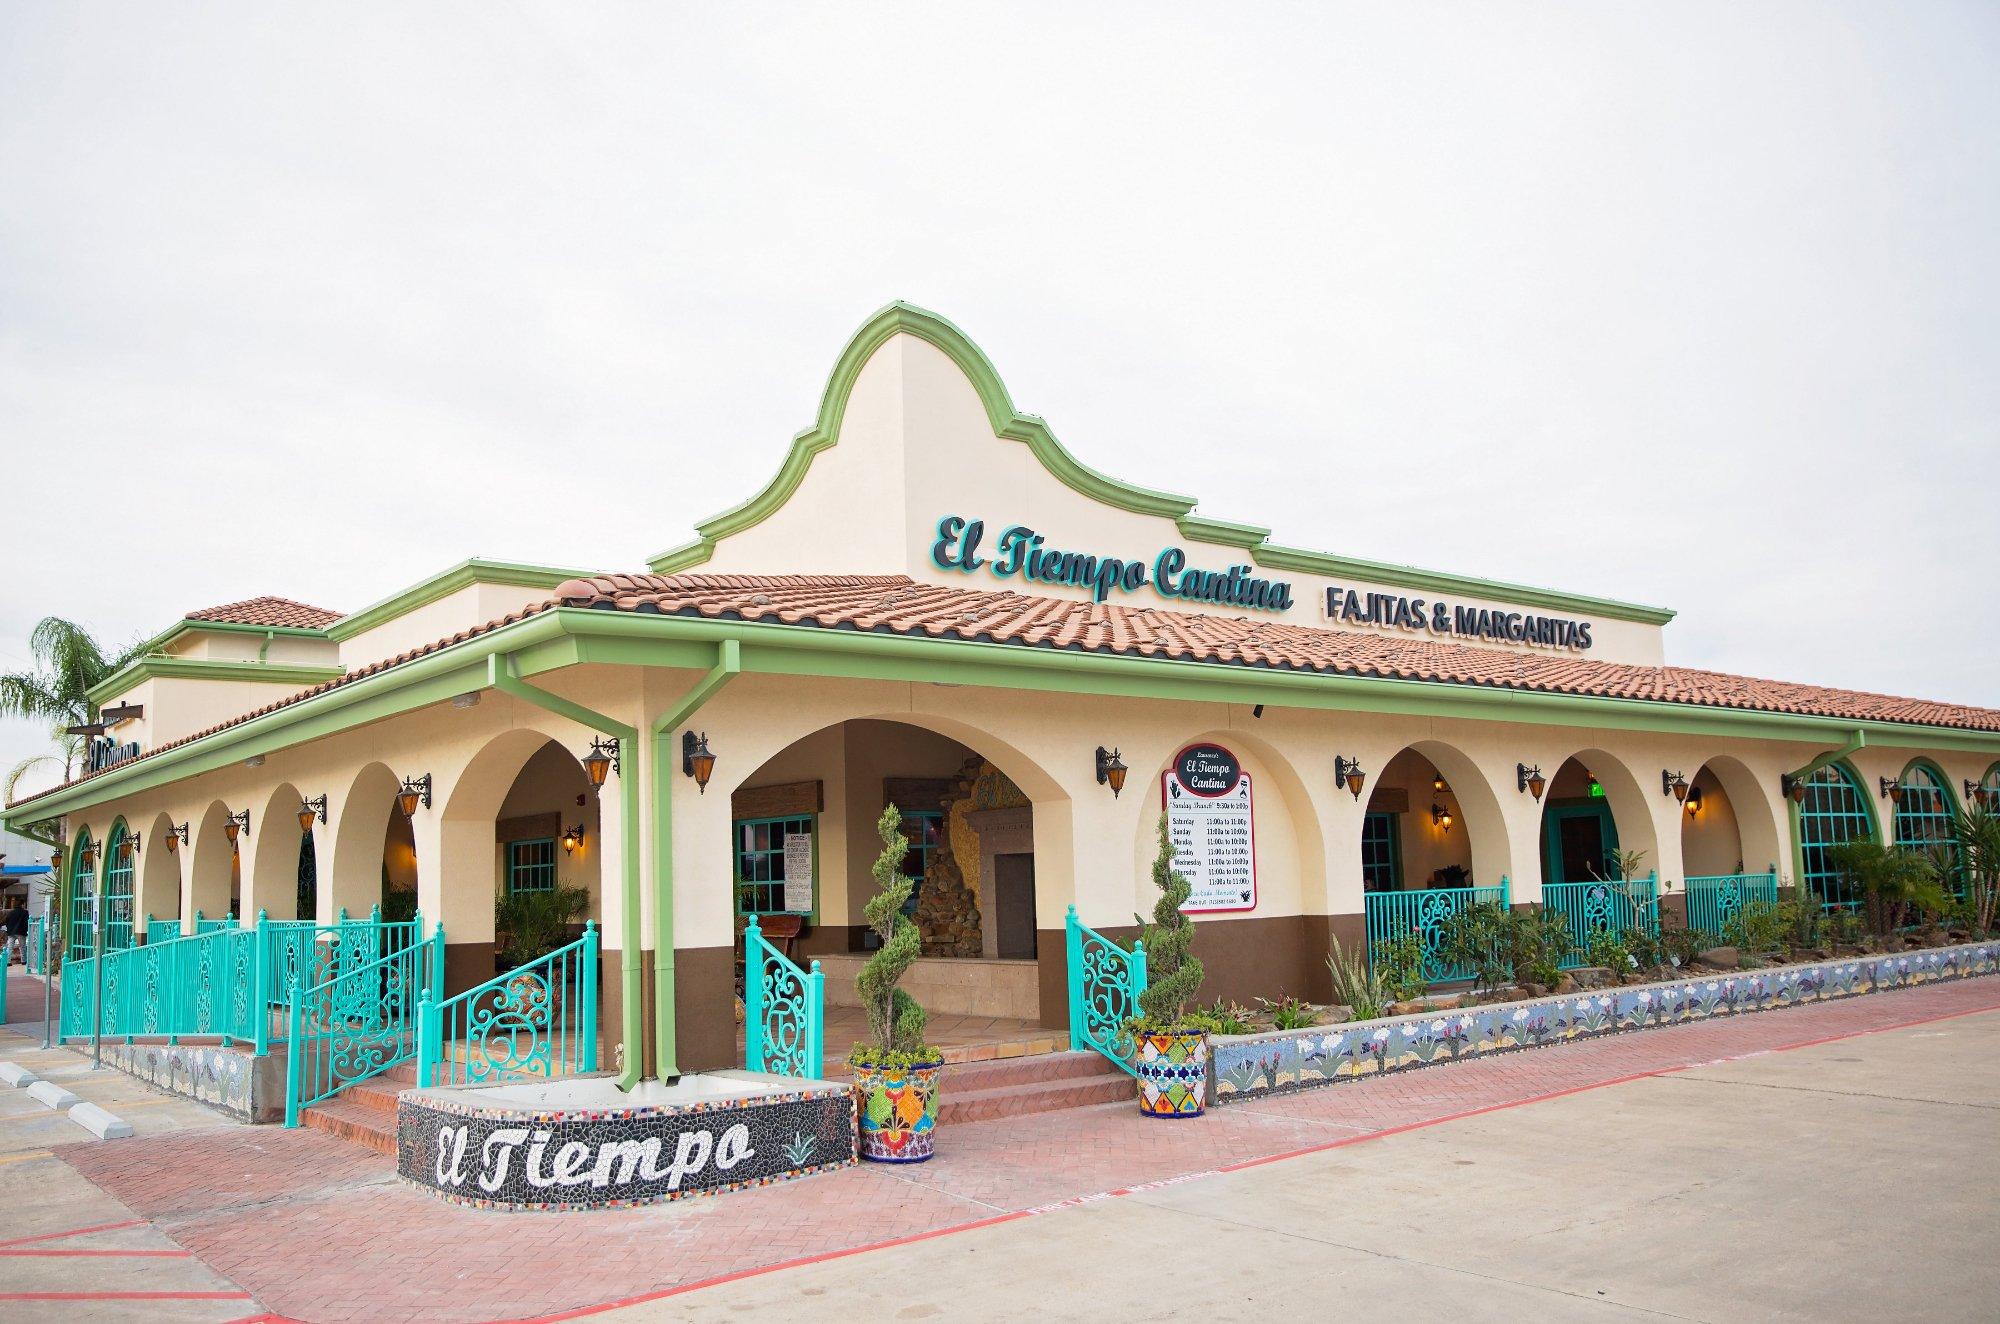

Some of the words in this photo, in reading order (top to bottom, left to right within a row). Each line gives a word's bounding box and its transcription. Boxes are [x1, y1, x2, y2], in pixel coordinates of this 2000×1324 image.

[931, 515, 985, 572] El
[993, 525, 1149, 602] Tiempo
[1154, 546, 1295, 611] Cantina
[1325, 587, 1427, 629] FAJITAS
[1431, 602, 1451, 633] &
[1455, 605, 1592, 650] MARGARITAS
[1186, 760, 1197, 773] El
[1198, 761, 1230, 777] Tiempo
[1191, 776, 1227, 789] Cantina
[1173, 817, 1195, 826] Saturday
[1173, 828, 1191, 836] Sunday
[436, 1124, 469, 1187] El
[477, 1122, 755, 1193] Tiempo
